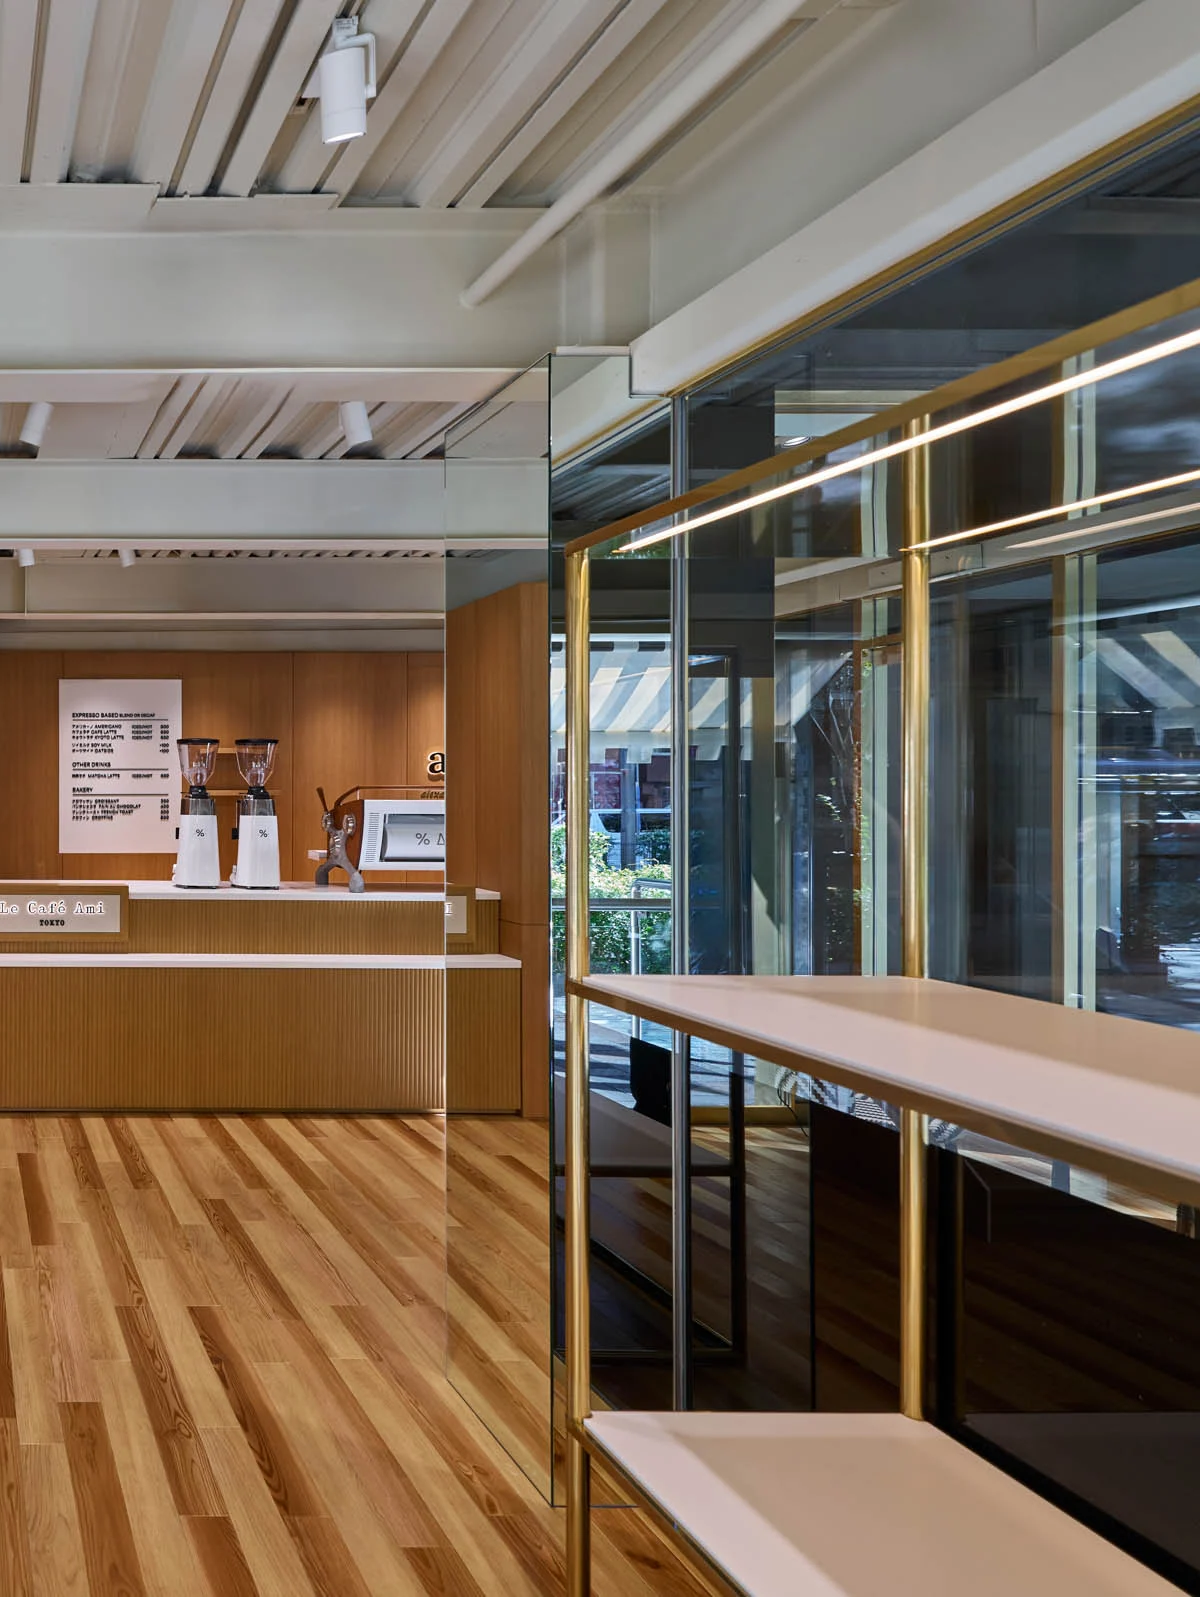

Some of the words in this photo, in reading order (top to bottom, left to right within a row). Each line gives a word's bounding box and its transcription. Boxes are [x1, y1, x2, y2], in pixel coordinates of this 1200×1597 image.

[0, 902, 18, 914] Le
[28, 902, 66, 914] Café
[74, 902, 105, 914] Ami
